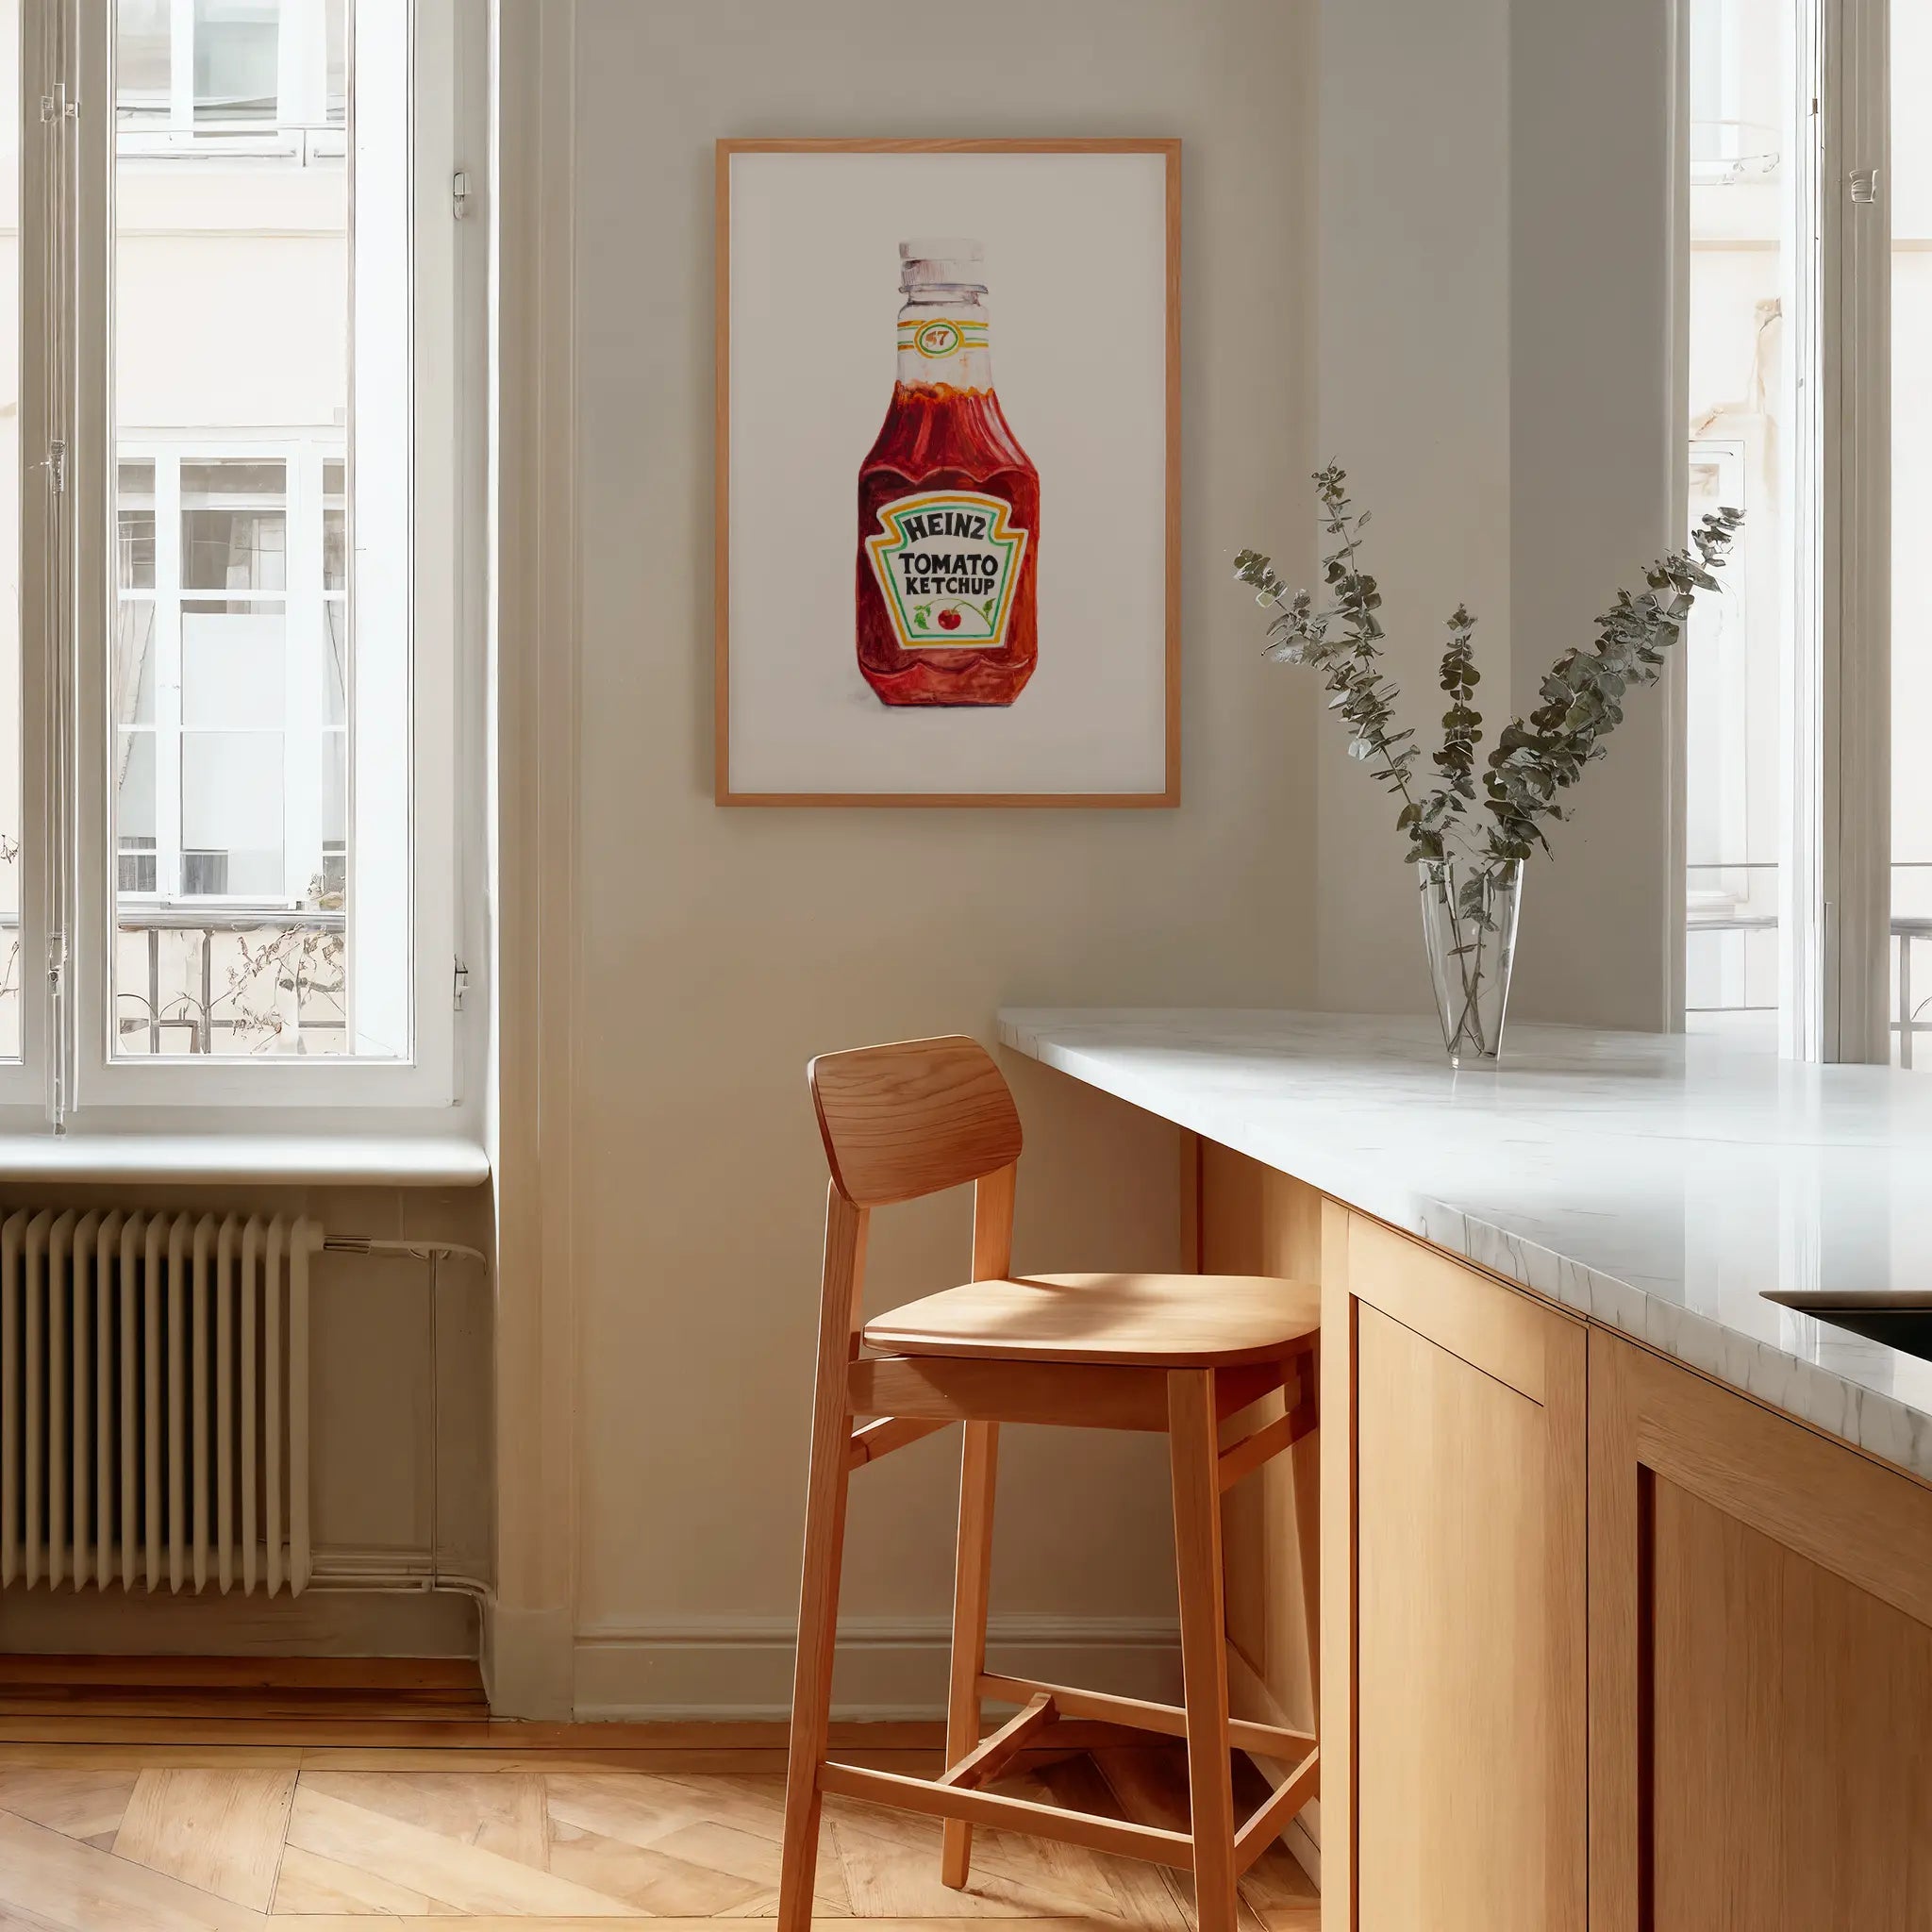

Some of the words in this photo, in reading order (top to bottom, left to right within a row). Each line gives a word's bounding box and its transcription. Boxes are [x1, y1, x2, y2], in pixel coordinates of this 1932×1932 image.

[902, 512, 987, 542] HEINZ
[898, 553, 998, 576] TOMATO
[906, 576, 995, 595] KETCHUP
